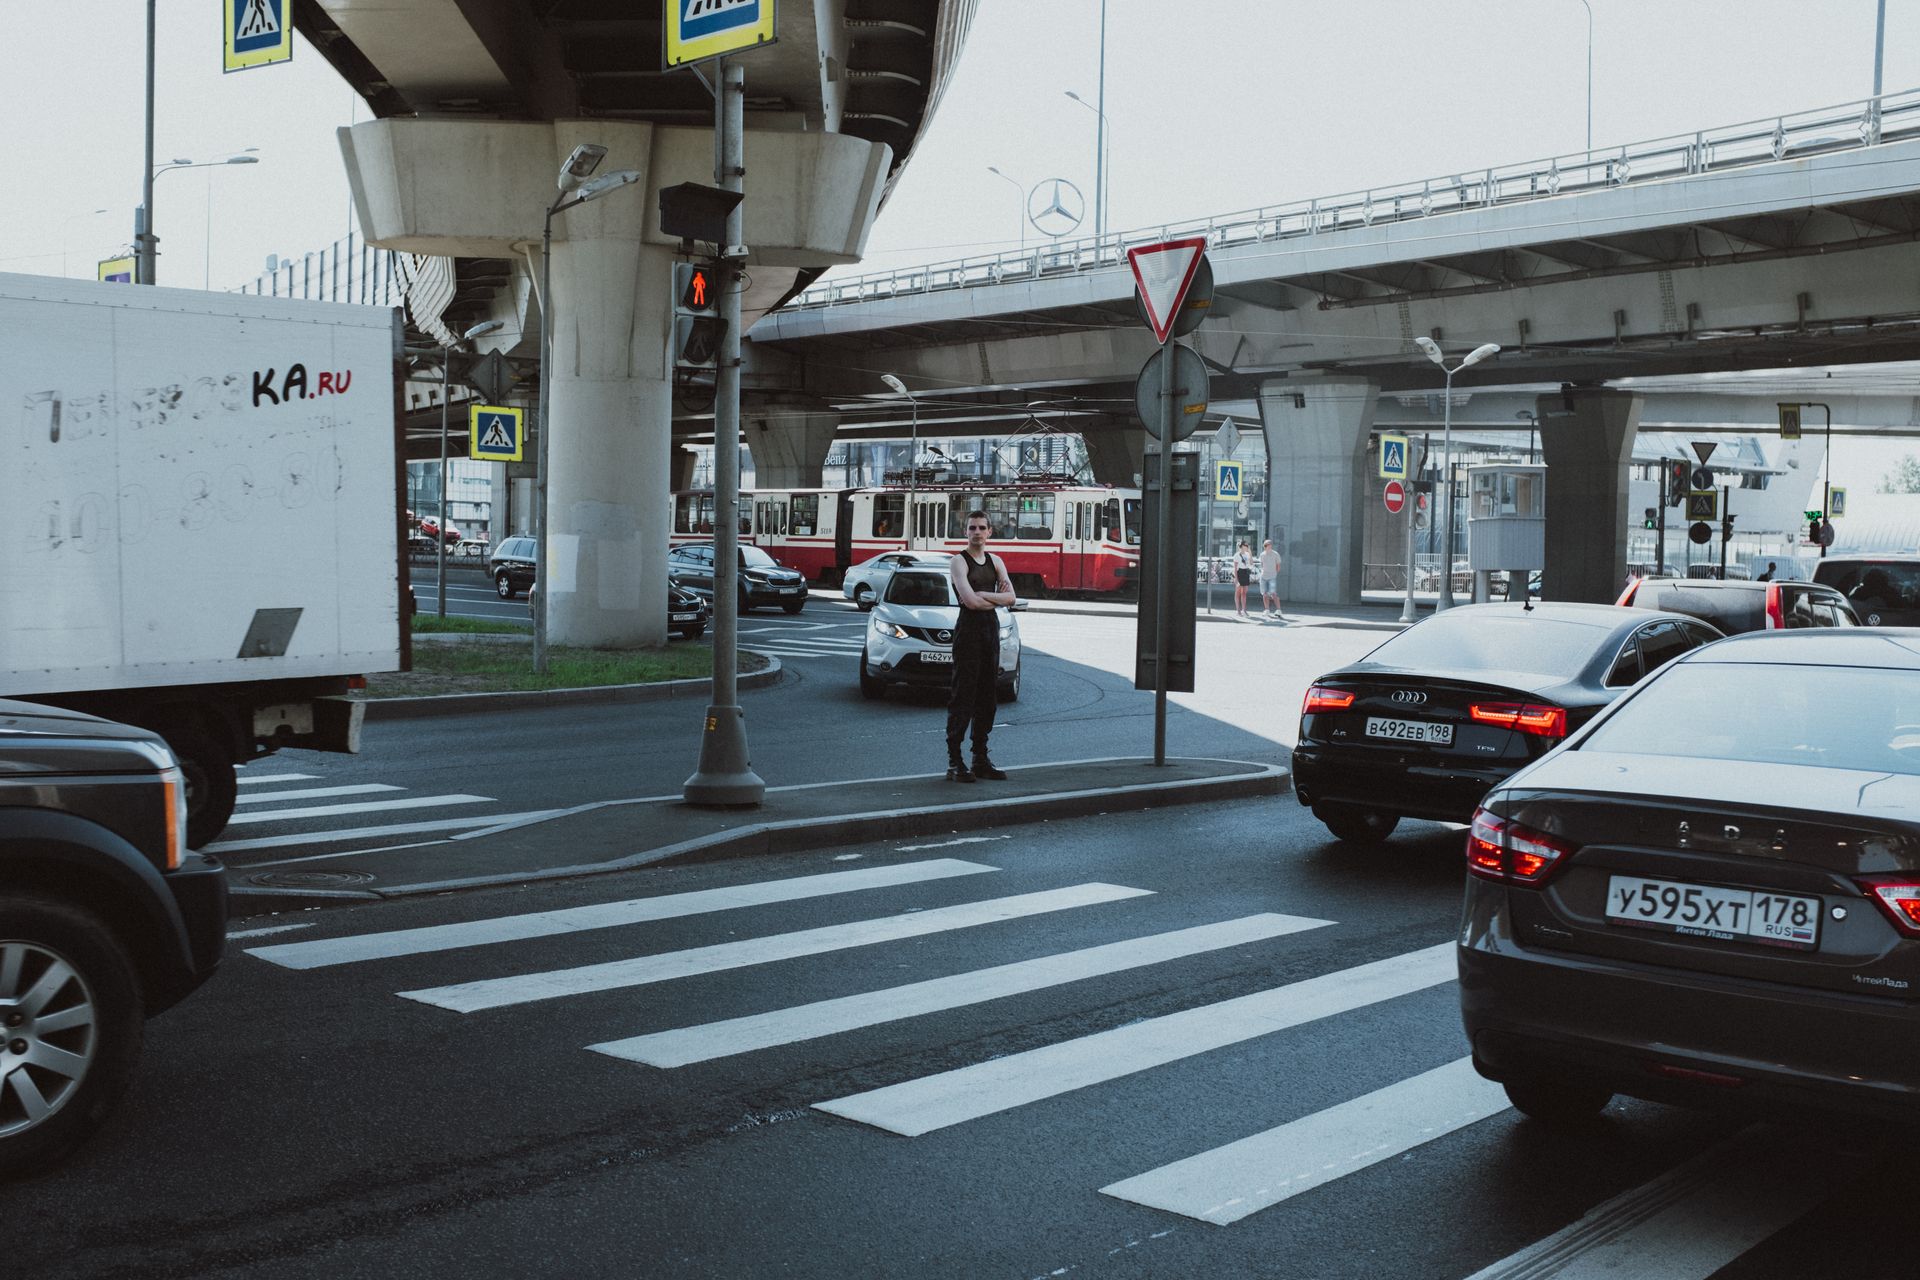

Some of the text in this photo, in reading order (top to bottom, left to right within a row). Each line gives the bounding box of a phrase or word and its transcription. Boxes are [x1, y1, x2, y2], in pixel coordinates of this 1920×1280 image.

[1369, 721, 1449, 740] В492ЕВ 198
[1619, 884, 1809, 929] У595ХТ 178
[1765, 924, 1792, 937] RUS
